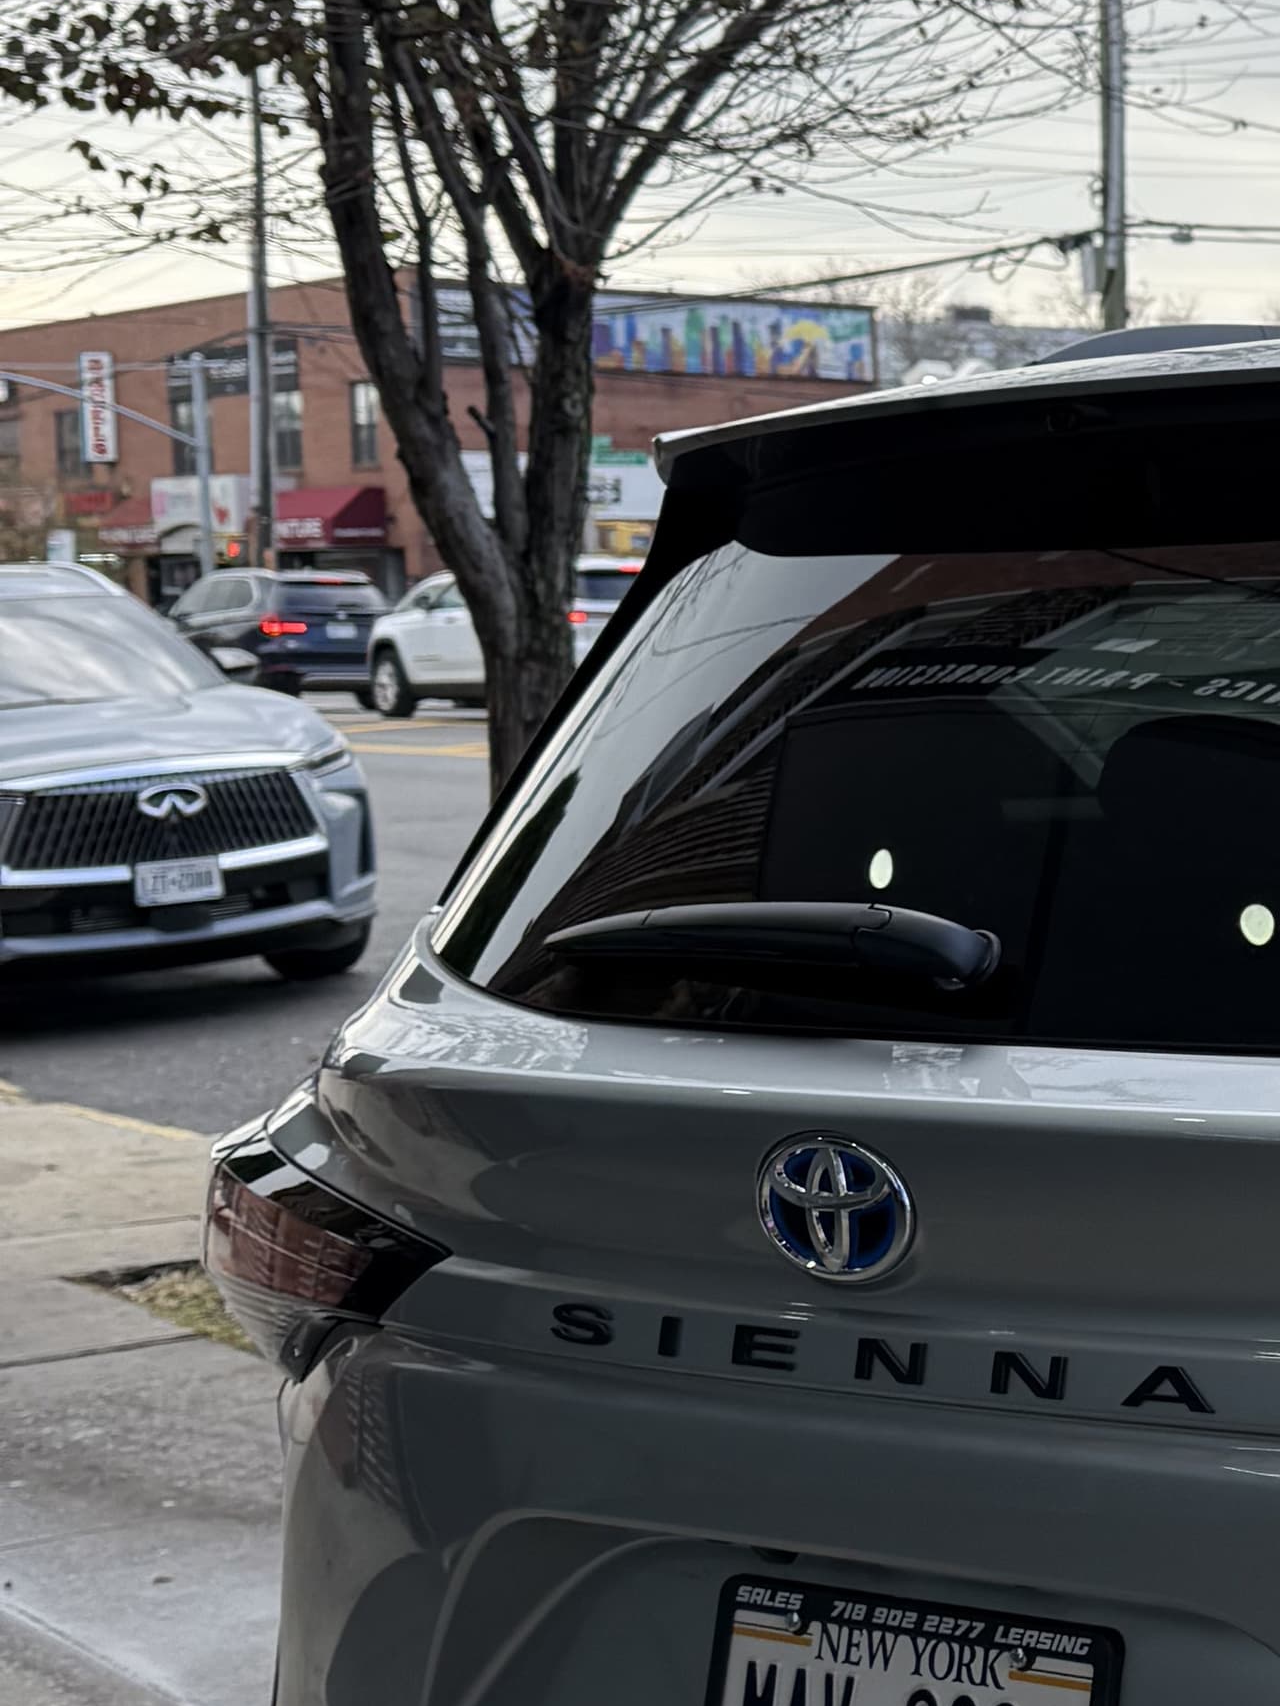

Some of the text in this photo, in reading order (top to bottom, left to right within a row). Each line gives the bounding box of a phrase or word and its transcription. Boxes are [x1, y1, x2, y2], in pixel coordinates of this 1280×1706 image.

[550, 1302, 1216, 1415] SIENNA
[736, 1585, 1092, 1656] SALES 718 902 2277 LEASING
[813, 1622, 1006, 1691] NEW YORK
